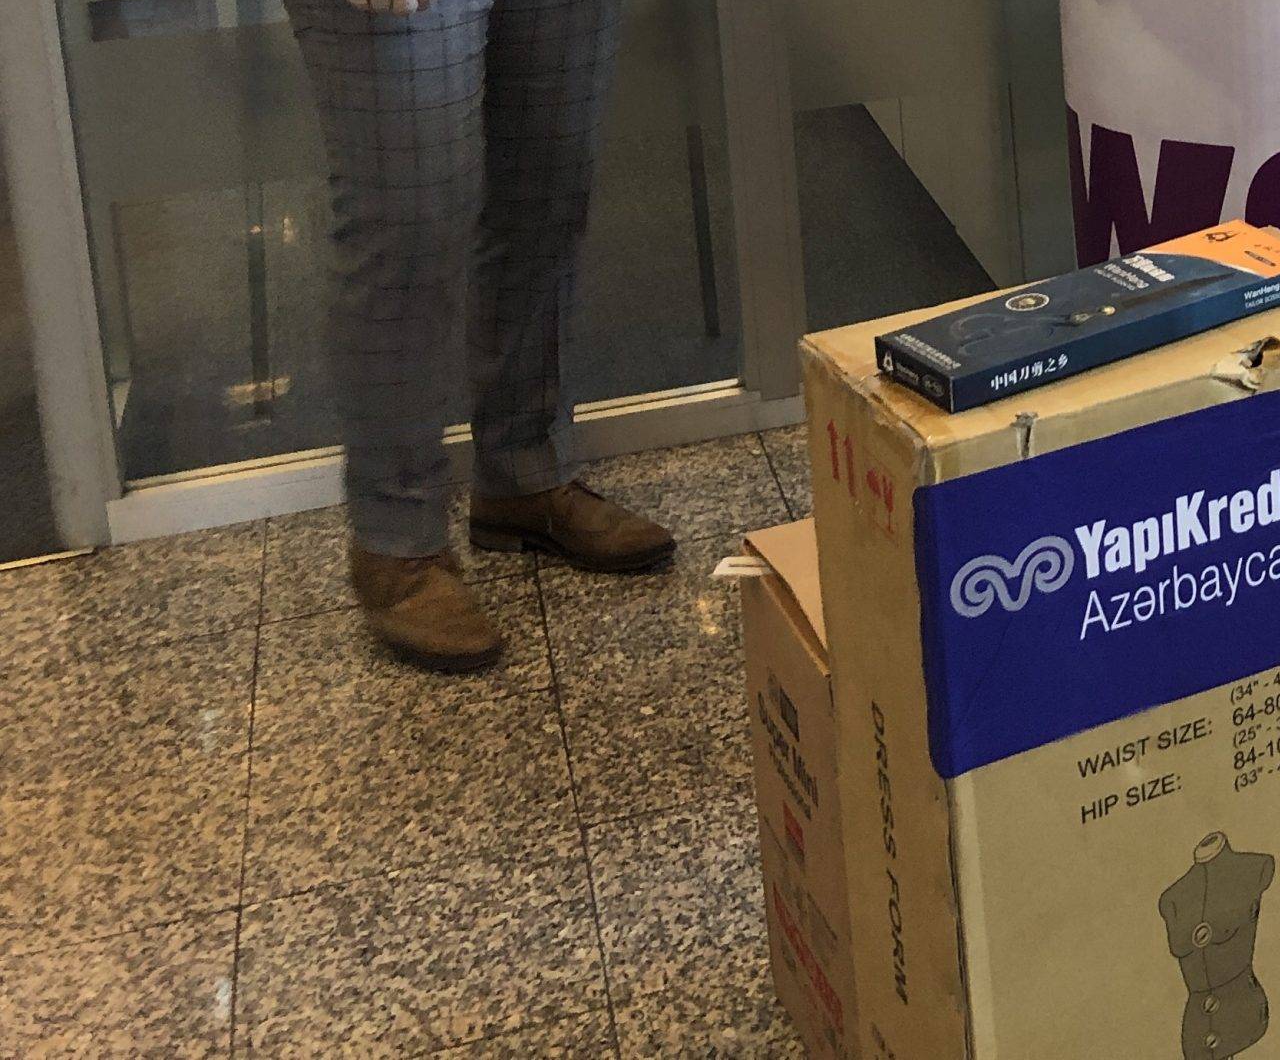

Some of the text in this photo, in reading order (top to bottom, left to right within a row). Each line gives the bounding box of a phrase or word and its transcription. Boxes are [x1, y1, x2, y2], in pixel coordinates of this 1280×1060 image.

[1243, 282, 1280, 300] WanHeng
[1077, 736, 1150, 778] WAIST
[1157, 717, 1213, 750] SIZE:
[1080, 794, 1119, 824] HIP
[1125, 772, 1183, 808] SIZE:
[870, 699, 908, 1006] DRESS FORM
